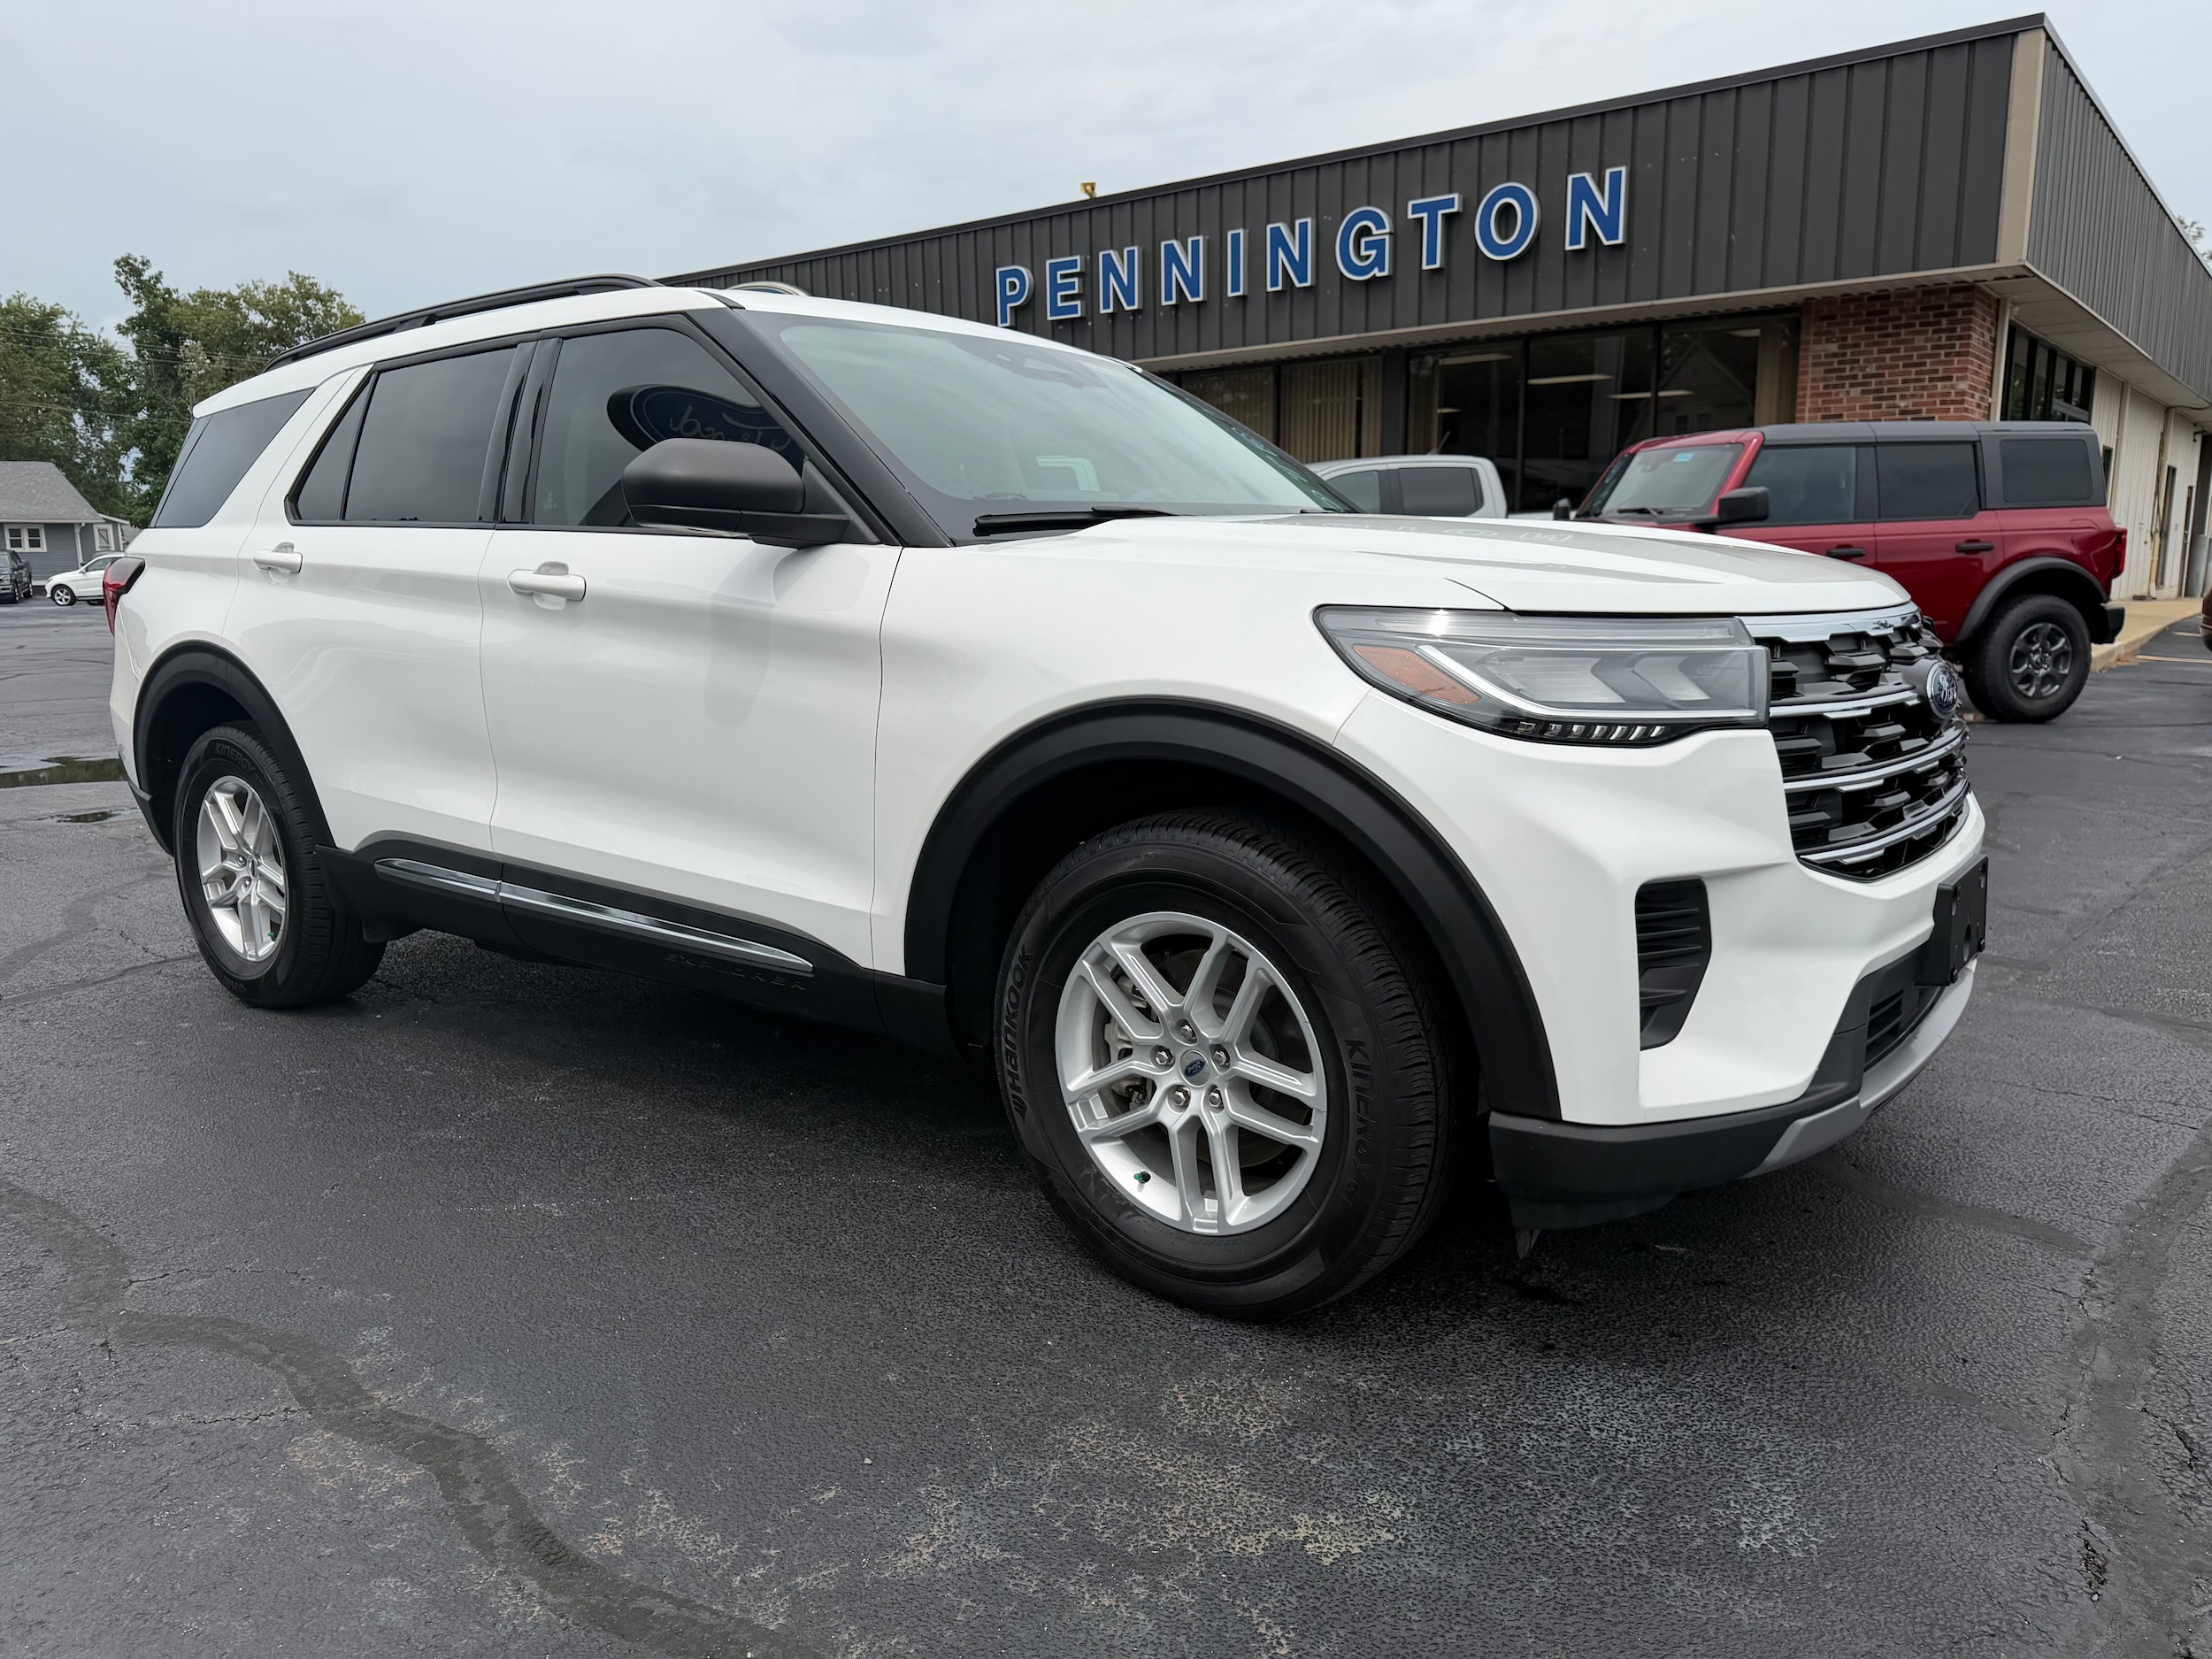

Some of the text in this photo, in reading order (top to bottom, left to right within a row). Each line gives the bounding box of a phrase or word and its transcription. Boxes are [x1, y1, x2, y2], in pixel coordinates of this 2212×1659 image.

[995, 165, 1627, 327] PENNINGTON
[214, 741, 256, 773] KINERGY
[663, 952, 807, 992] EXPLORER
[1344, 1039, 1377, 1184] KINERGY
